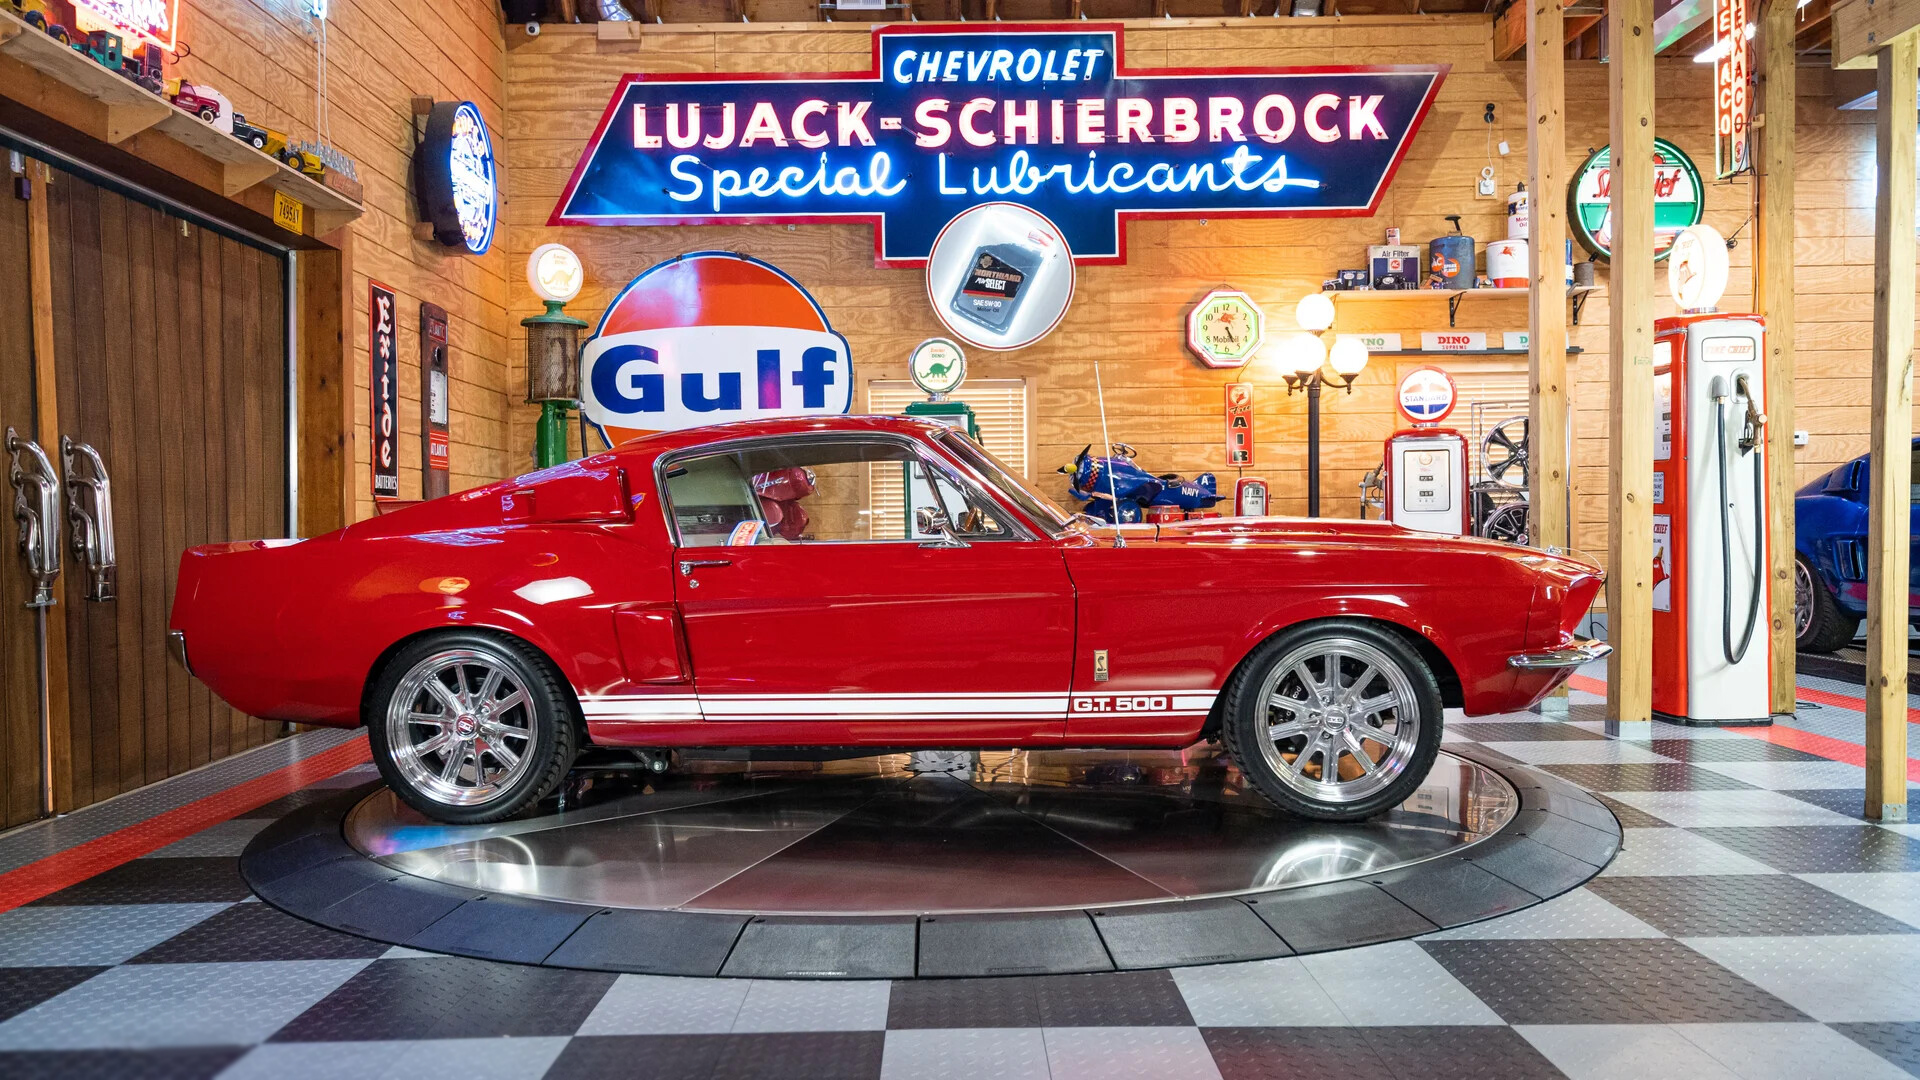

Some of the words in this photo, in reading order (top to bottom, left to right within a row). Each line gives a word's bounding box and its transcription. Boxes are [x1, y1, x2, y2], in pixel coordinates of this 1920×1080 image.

[892, 48, 1105, 84] CHEVROLET
[632, 94, 1390, 150] LUJACK-SCHIERBROCK
[666, 152, 907, 209] Special
[937, 144, 1320, 196] Lubricants
[1381, 250, 1391, 258] Air
[1392, 250, 1410, 258] Filter
[974, 268, 1021, 283] NORTHLAND
[985, 278, 1006, 291] SELECT
[973, 298, 985, 307] SAE
[1222, 303, 1230, 311] 12
[1205, 313, 1213, 321] 10
[1242, 313, 1247, 321] 2
[1245, 324, 1250, 332] 3
[1205, 335, 1211, 343] 8
[1242, 335, 1248, 343] 4
[1437, 335, 1471, 345] DINO
[1727, 344, 1753, 354] CHIEF
[590, 344, 838, 416] Gulf
[1231, 416, 1249, 462] AIR
[430, 441, 448, 458] ATLANTIC
[374, 473, 398, 491] BATTERIES
[1200, 474, 1209, 486] A
[1181, 486, 1200, 498] NAVY
[1073, 697, 1112, 712] G.T.
[1115, 696, 1168, 712] 500
